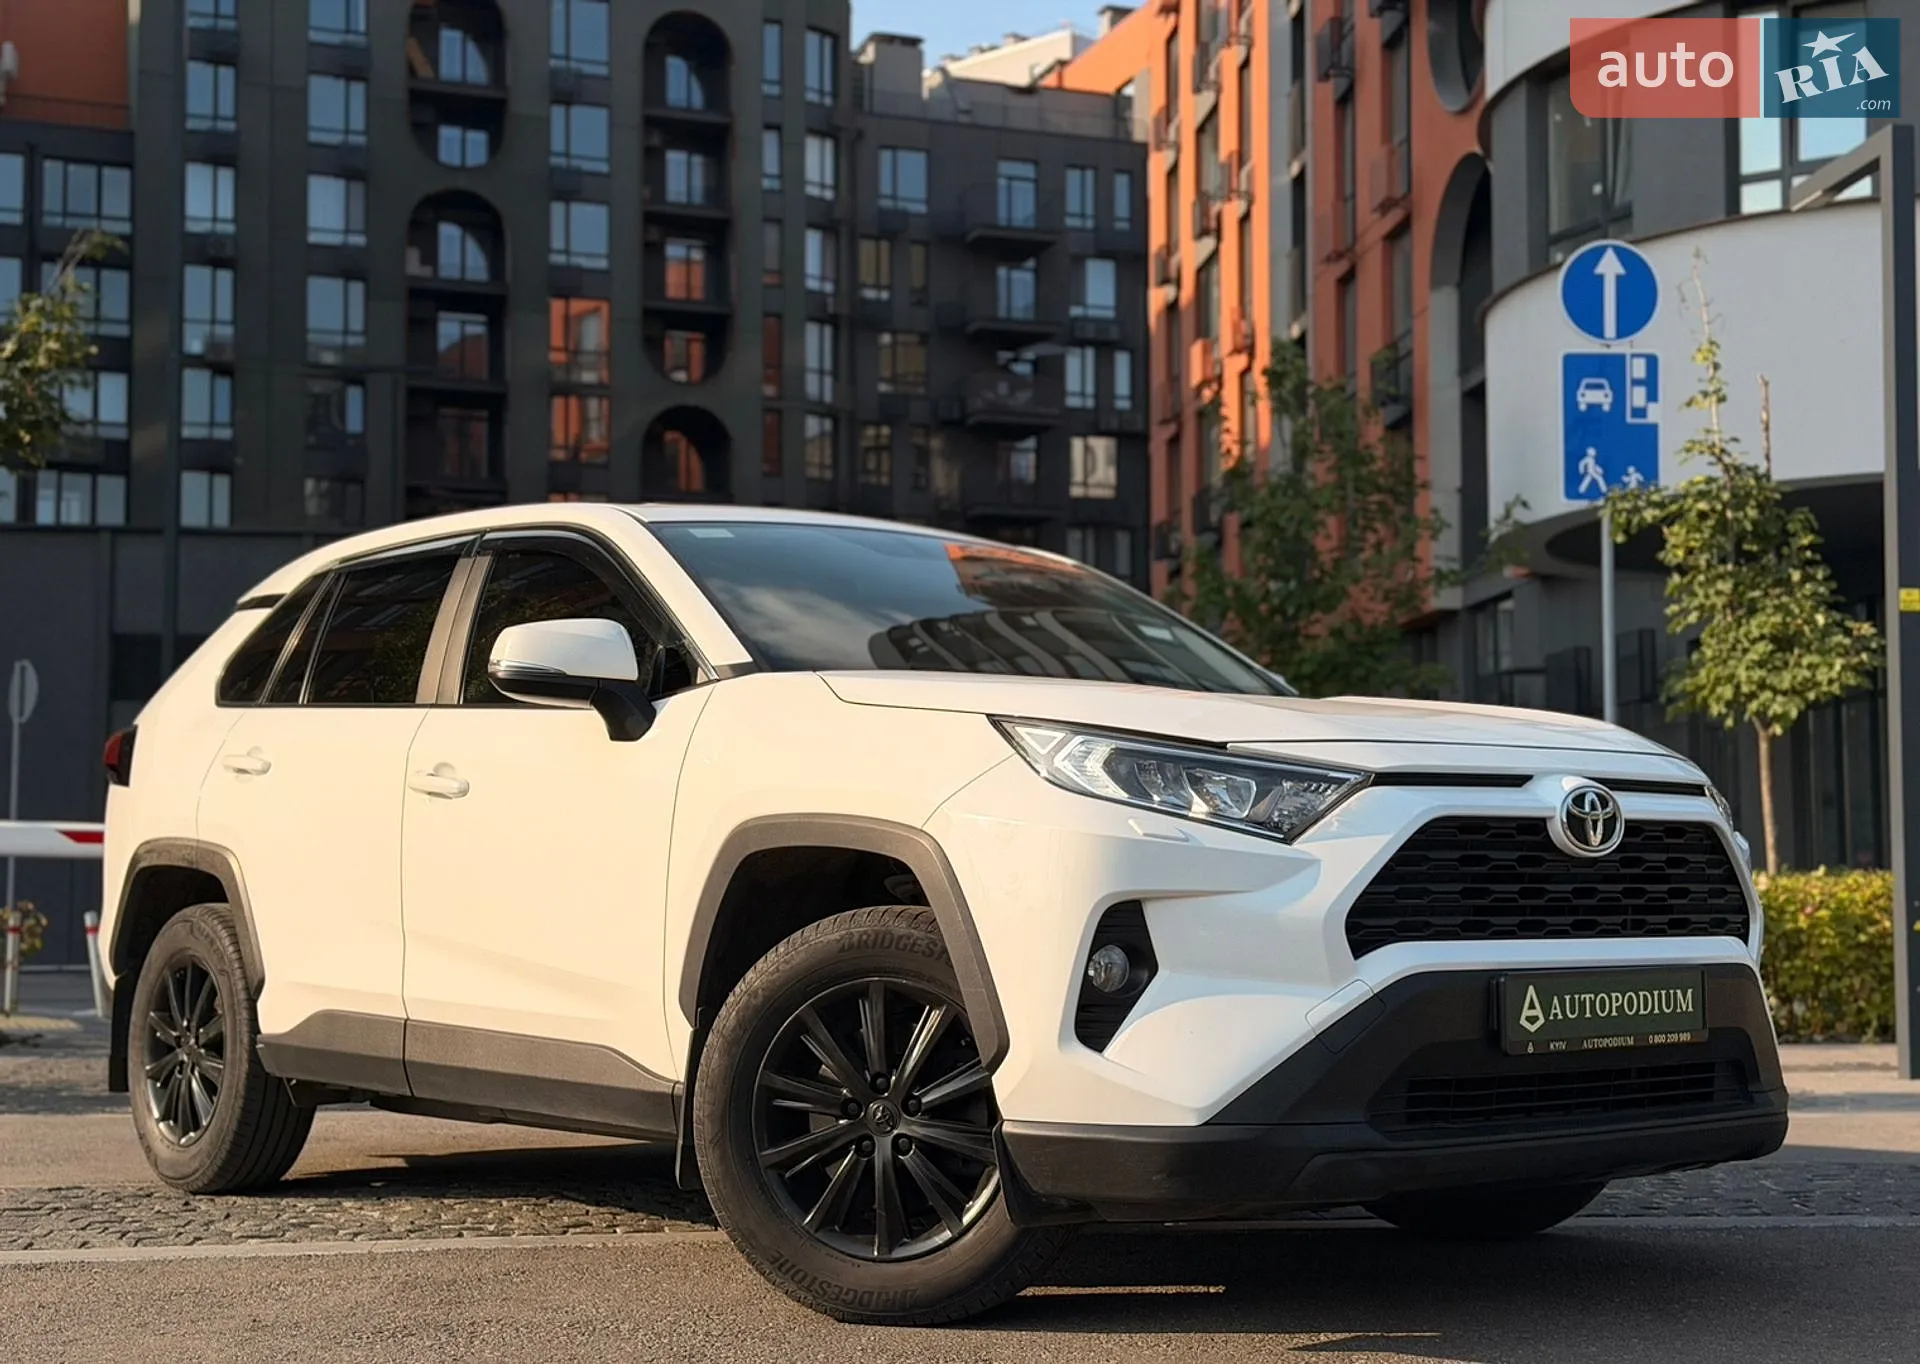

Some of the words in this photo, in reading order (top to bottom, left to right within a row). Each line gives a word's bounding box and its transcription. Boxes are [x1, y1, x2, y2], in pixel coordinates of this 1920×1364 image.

[1549, 988, 1694, 1020] AUTOPODIUM
[1549, 1040, 1568, 1051] KYIV
[1581, 1036, 1634, 1049] AUTOPODIUM
[766, 1249, 920, 1311] BRIDGESTONE
